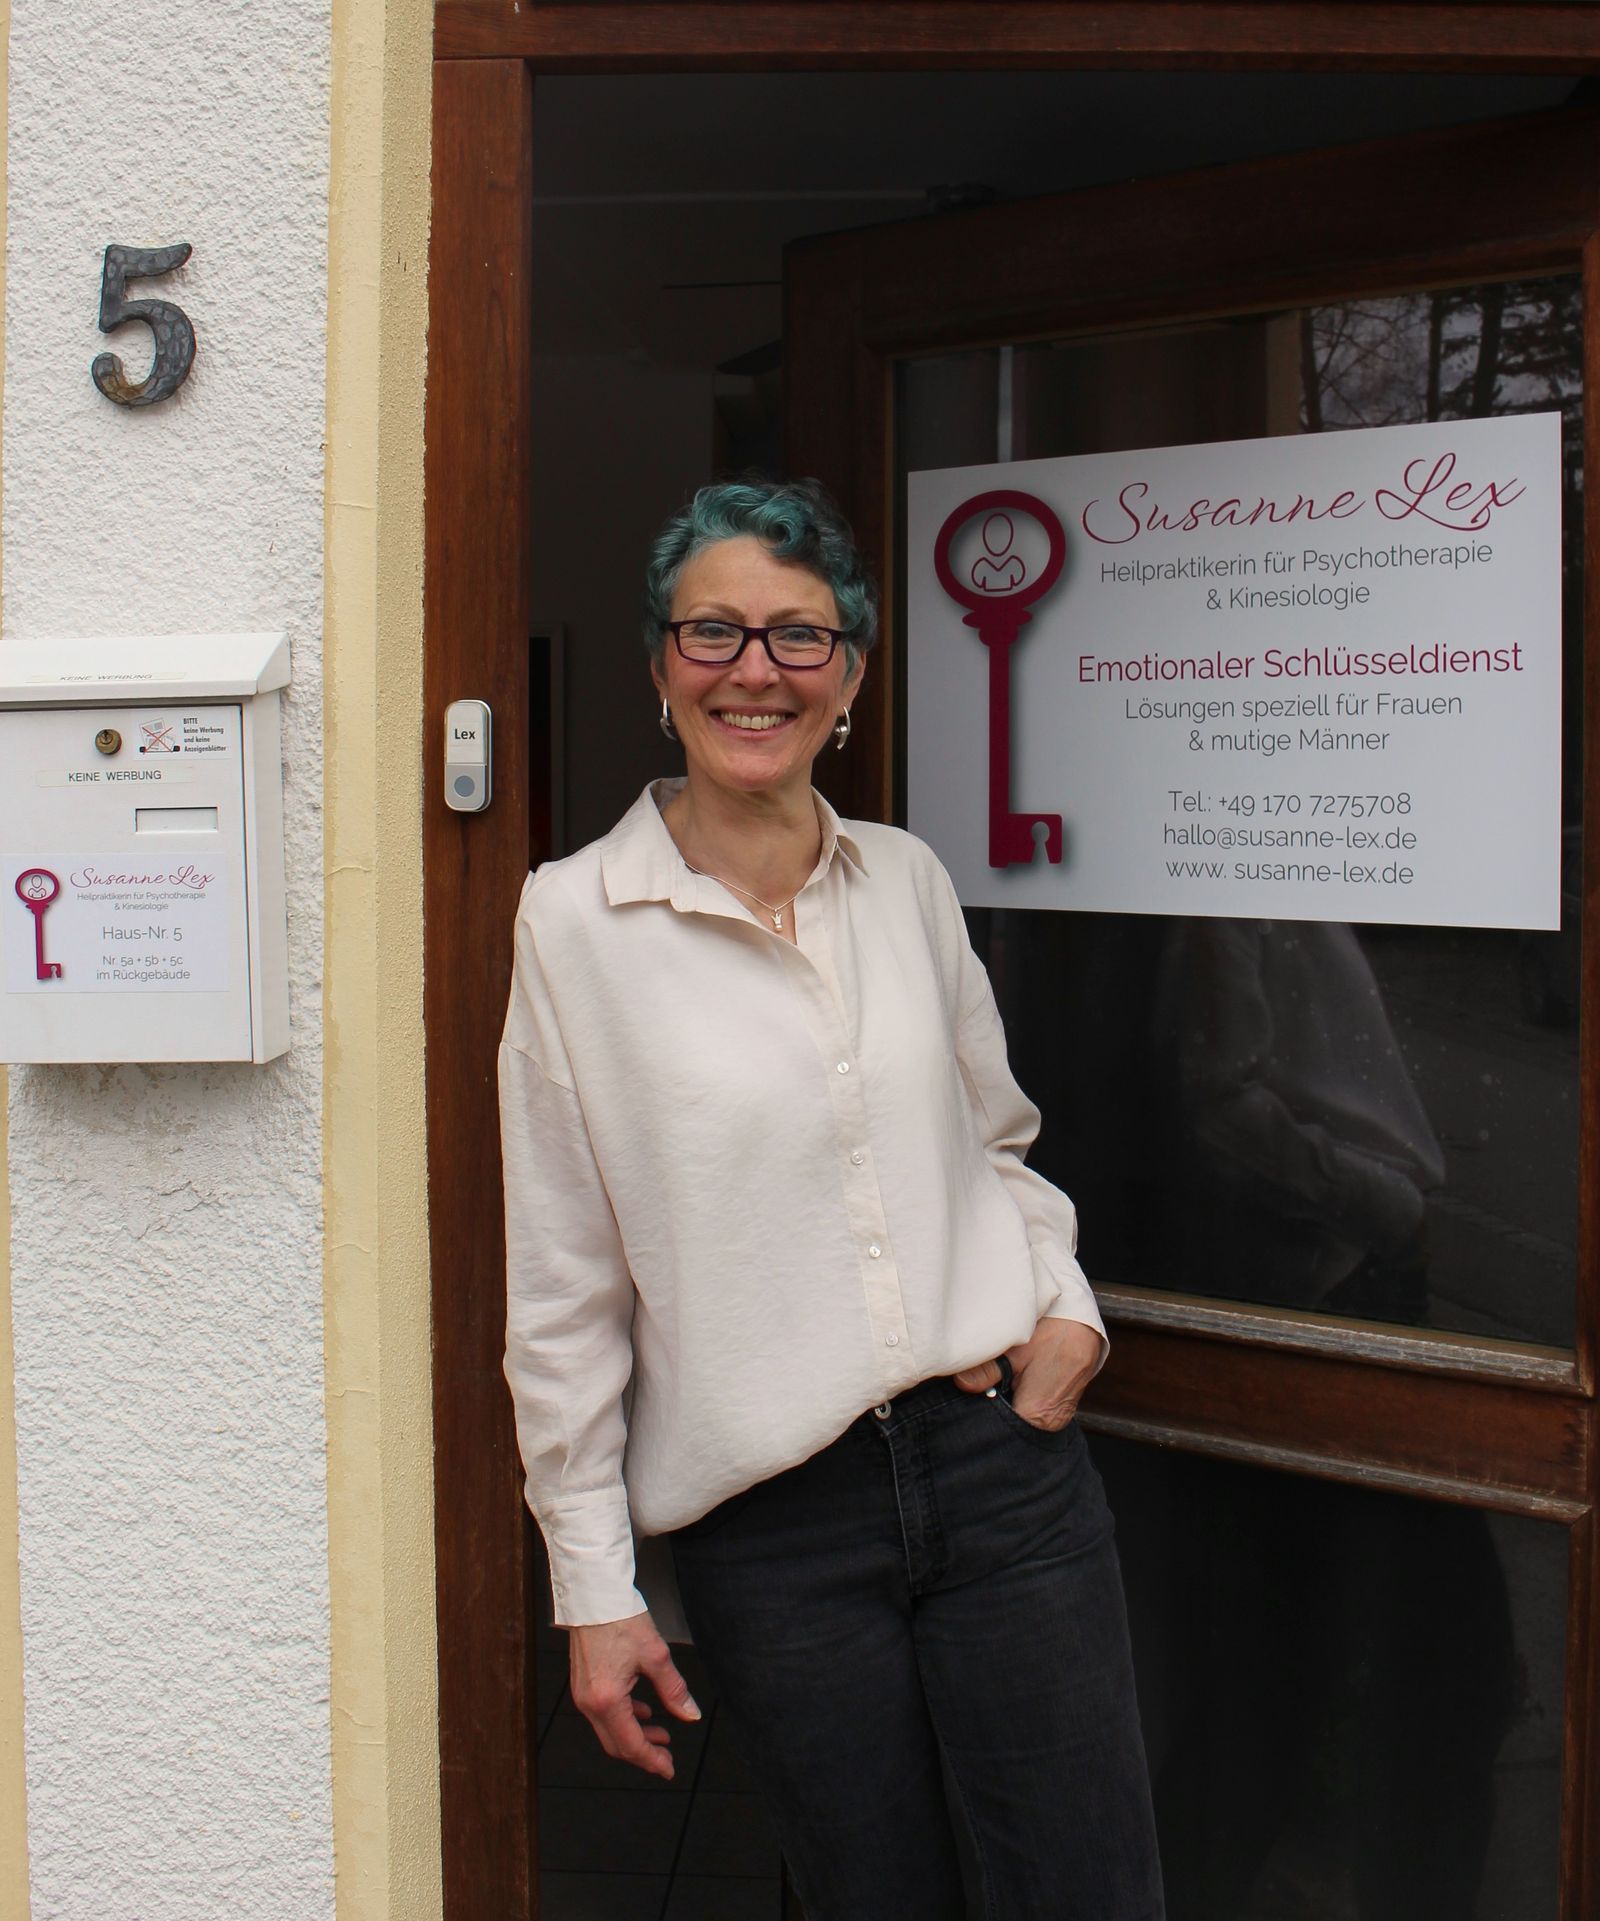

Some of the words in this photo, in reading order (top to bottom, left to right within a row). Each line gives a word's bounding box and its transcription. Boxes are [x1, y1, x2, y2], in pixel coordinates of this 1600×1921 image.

[92, 242, 196, 409] 5
[1082, 482, 1365, 544] Susanne
[1376, 452, 1527, 532] Lex
[1100, 554, 1257, 584] Heilpraktikerin
[1263, 551, 1295, 576] für
[1302, 541, 1493, 576] Psychotherapie
[1206, 588, 1222, 610] &
[1229, 584, 1370, 612] Kinesiologie
[1078, 651, 1255, 682] Emotionaler
[1264, 643, 1523, 678] Schlüsseldienst
[1126, 698, 1235, 725] Lösungen
[1242, 694, 1330, 722] speziell
[1336, 694, 1371, 716] für
[1377, 694, 1462, 716] Frauen
[455, 729, 475, 740] Lex
[1189, 731, 1204, 750] &
[1211, 729, 1291, 756] mutige
[1299, 728, 1390, 751] Männer
[68, 772, 100, 782] KEINE
[106, 771, 162, 781] WERBUNG
[1168, 791, 1212, 813] Tel.:
[1218, 797, 1255, 817] +49
[1263, 794, 1301, 815] 170
[1309, 793, 1412, 818] 7275708
[1163, 824, 1417, 851] hallo@susanne-lex.de
[70, 868, 165, 888] Susanne
[169, 865, 215, 890] Lex
[1166, 861, 1228, 879] www.
[1234, 860, 1414, 885] susanne-lex.de
[77, 893, 131, 902] Heilpraktikerin
[133, 892, 144, 900] für
[146, 892, 206, 901] Psychotherapie
[122, 902, 168, 911] Kinesiologie
[174, 927, 182, 941] 5
[121, 956, 133, 967] 5a
[145, 956, 159, 967] 5b
[170, 956, 183, 967] 5c
[97, 970, 110, 980] im
[113, 969, 190, 982] Rückgebäude
